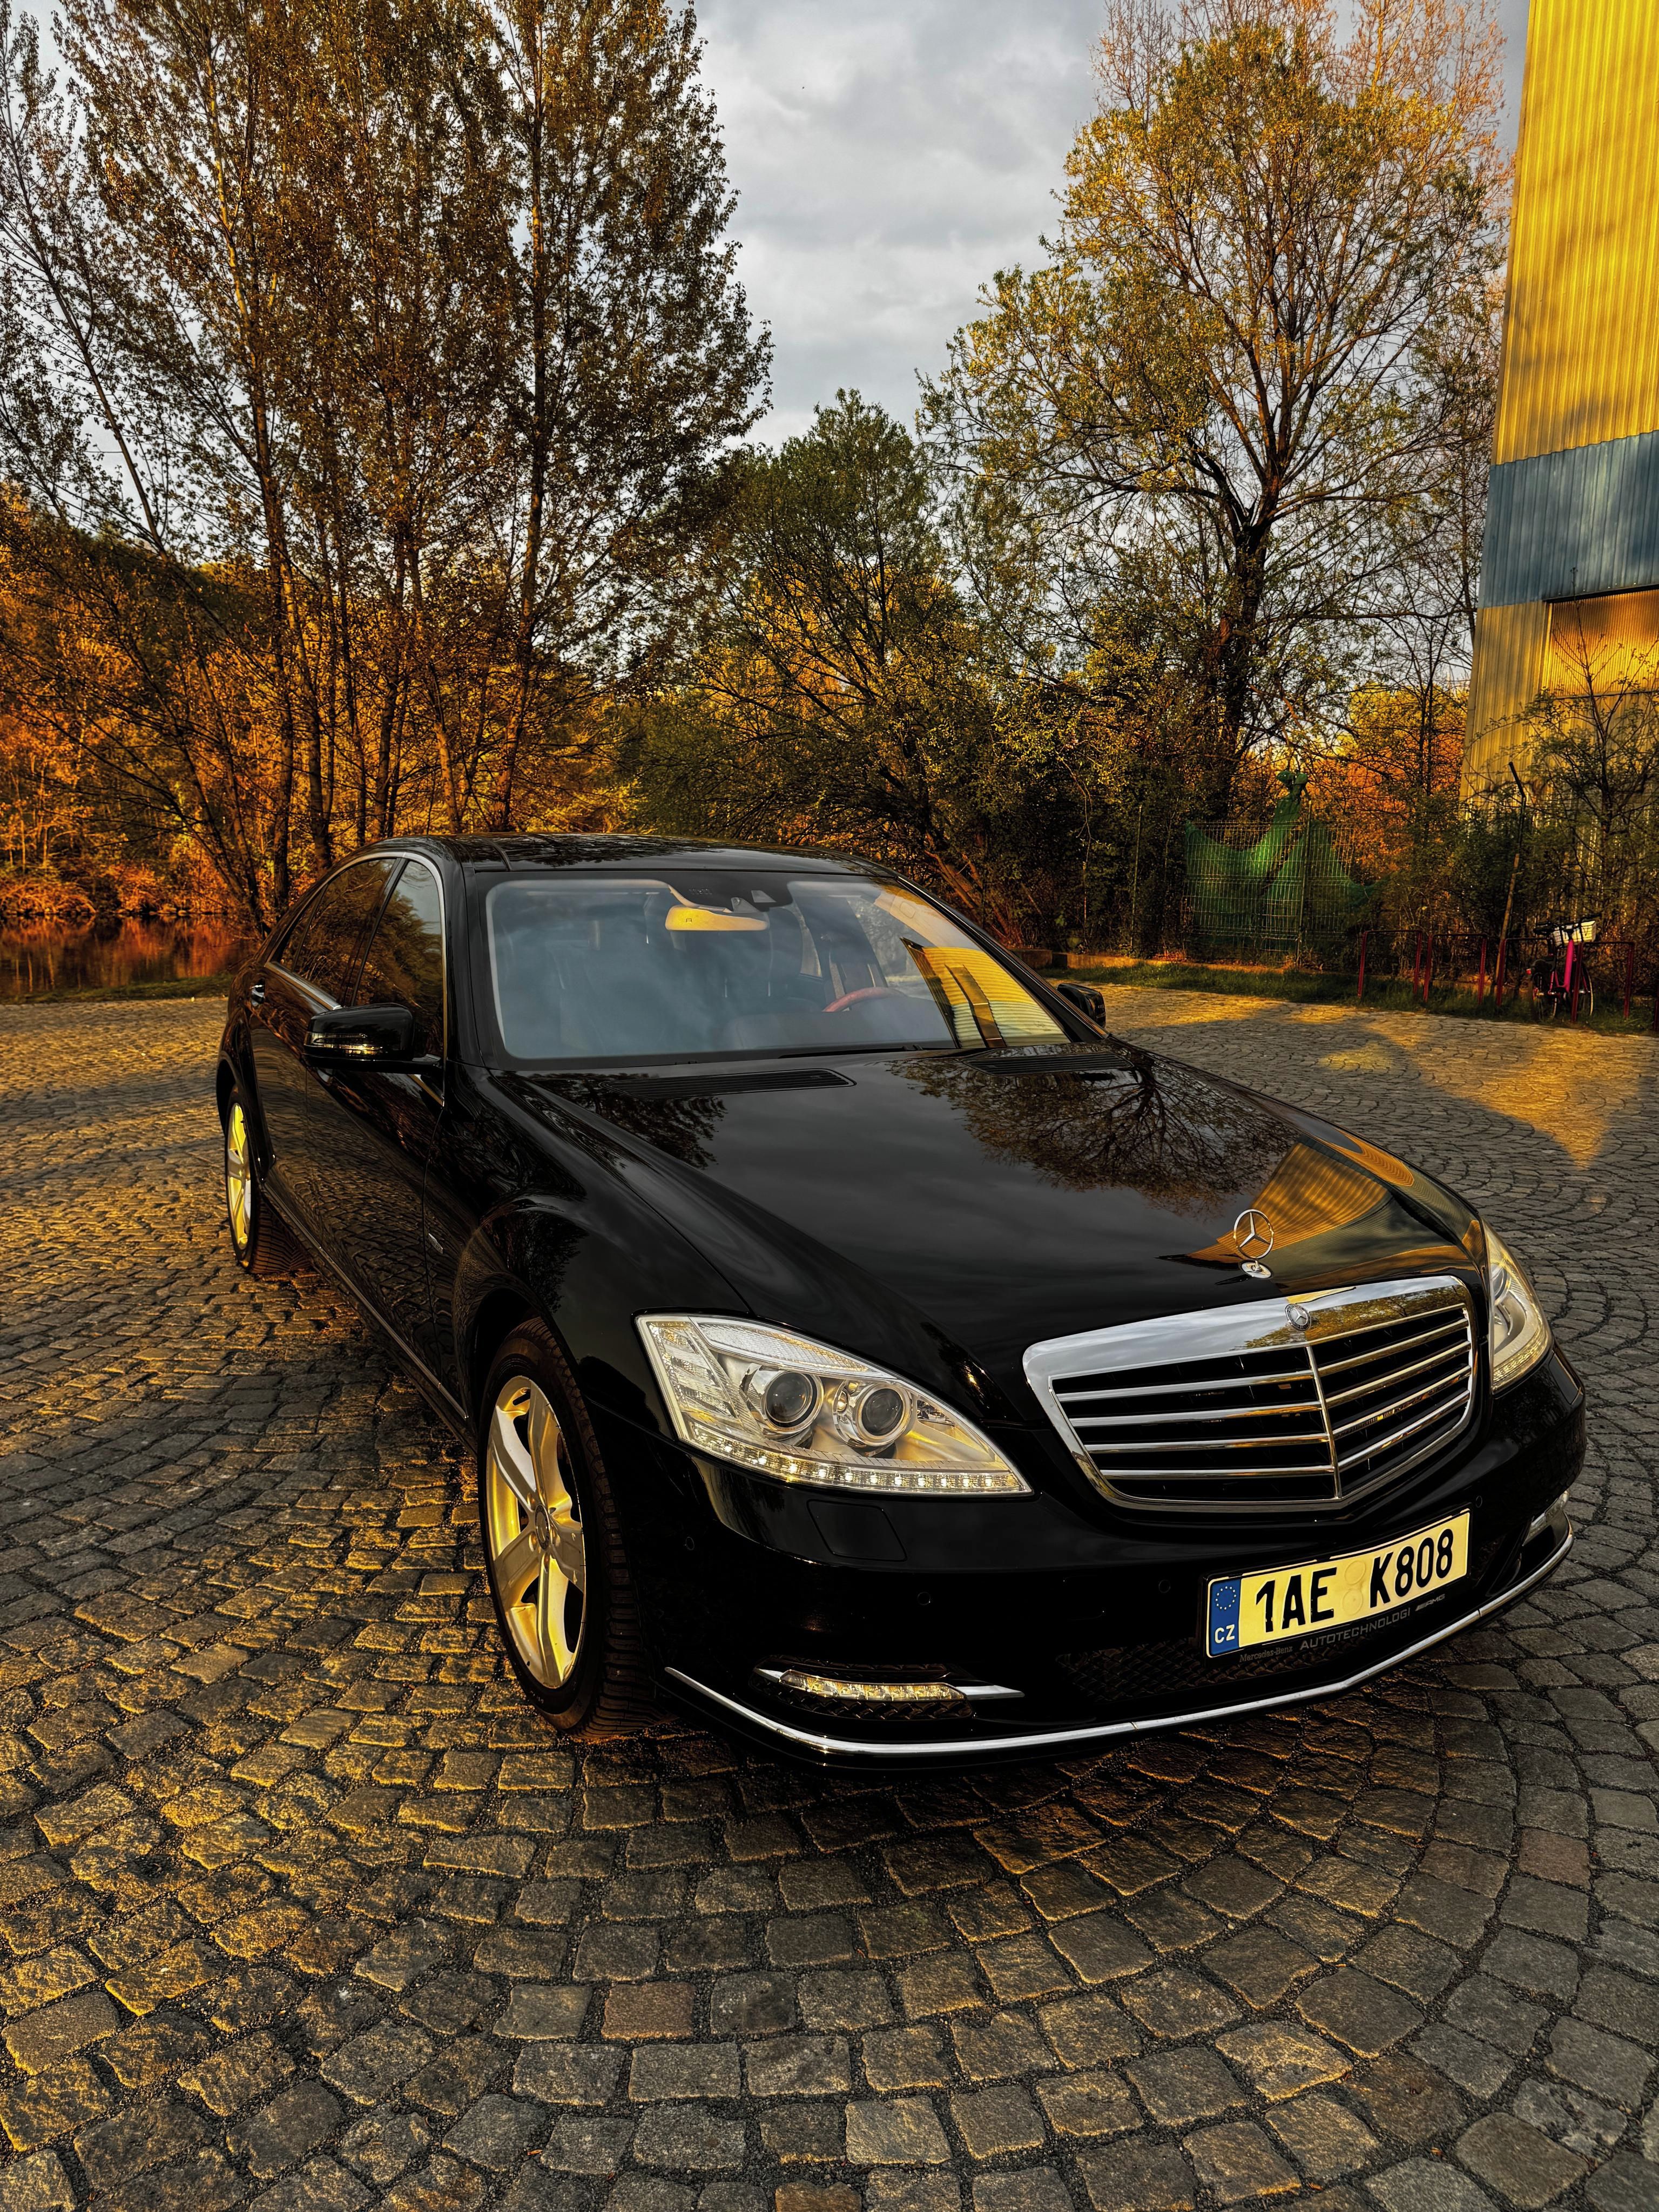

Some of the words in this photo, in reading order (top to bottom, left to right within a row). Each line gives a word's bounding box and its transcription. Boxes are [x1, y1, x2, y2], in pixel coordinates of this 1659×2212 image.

[1255, 1567, 1337, 1633] 1AE
[1370, 1528, 1454, 1609] K808
[1214, 1623, 1236, 1644] CZ
[1239, 1644, 1293, 1663] Mercedes-Benz
